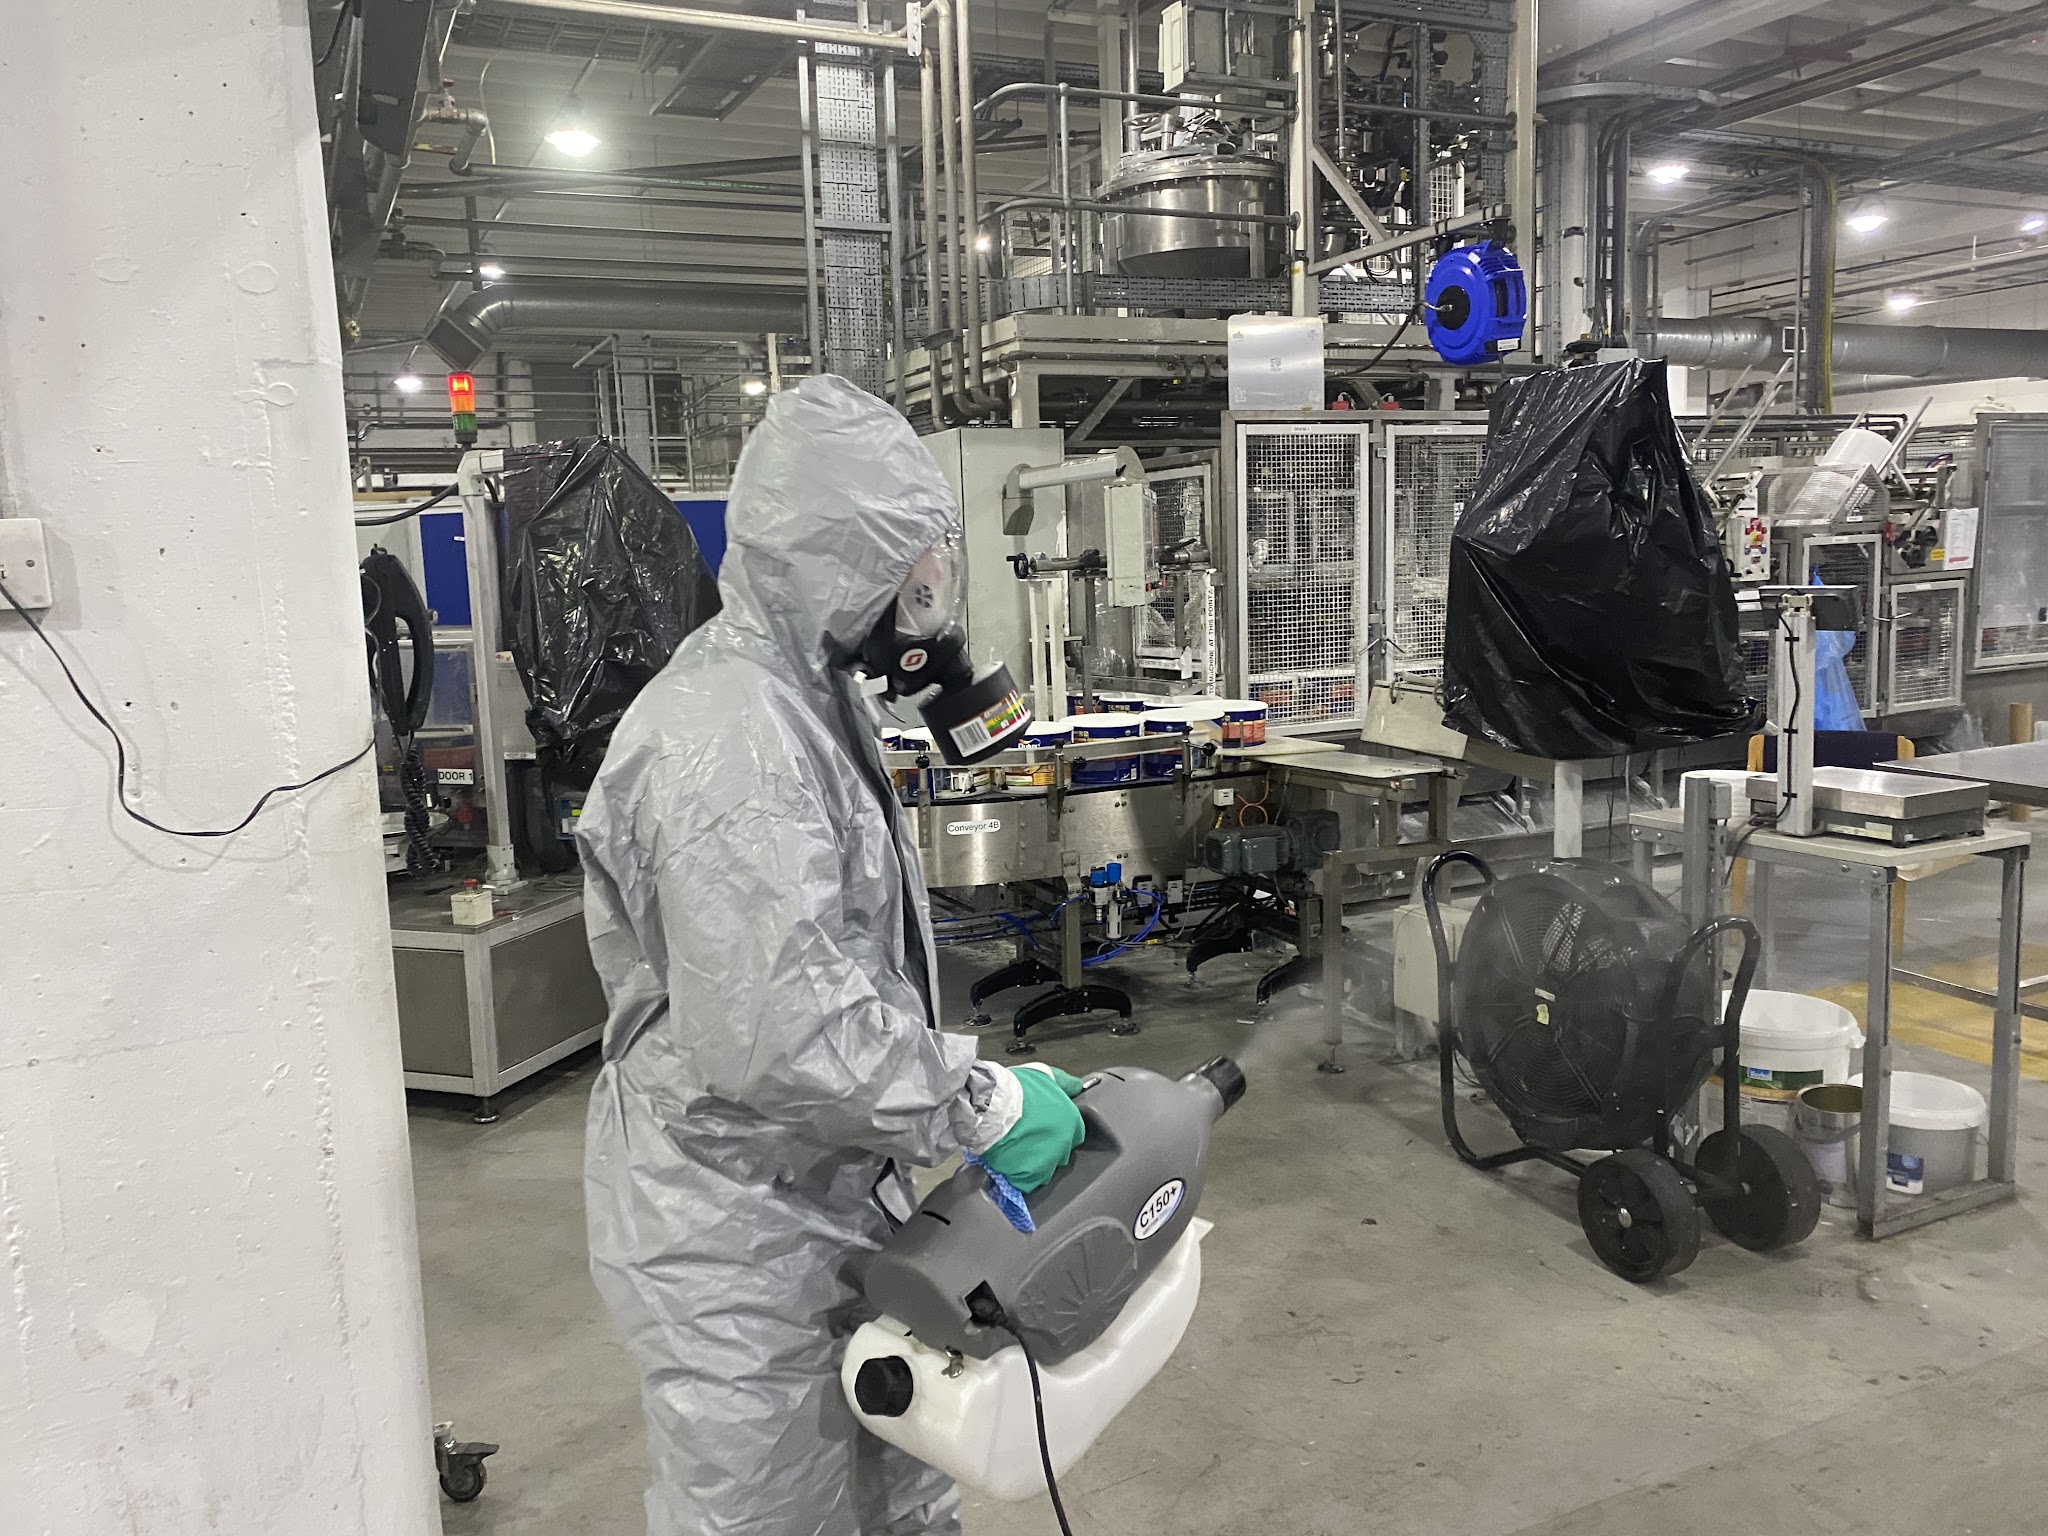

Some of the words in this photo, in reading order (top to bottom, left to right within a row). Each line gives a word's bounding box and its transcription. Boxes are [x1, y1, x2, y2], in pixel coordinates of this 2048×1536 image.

[1208, 639, 1214, 647] AT
[438, 771, 465, 780] DOOR
[948, 823, 986, 832] Conveyor
[988, 821, 999, 829] 4B
[1140, 1186, 1177, 1228] C150+
